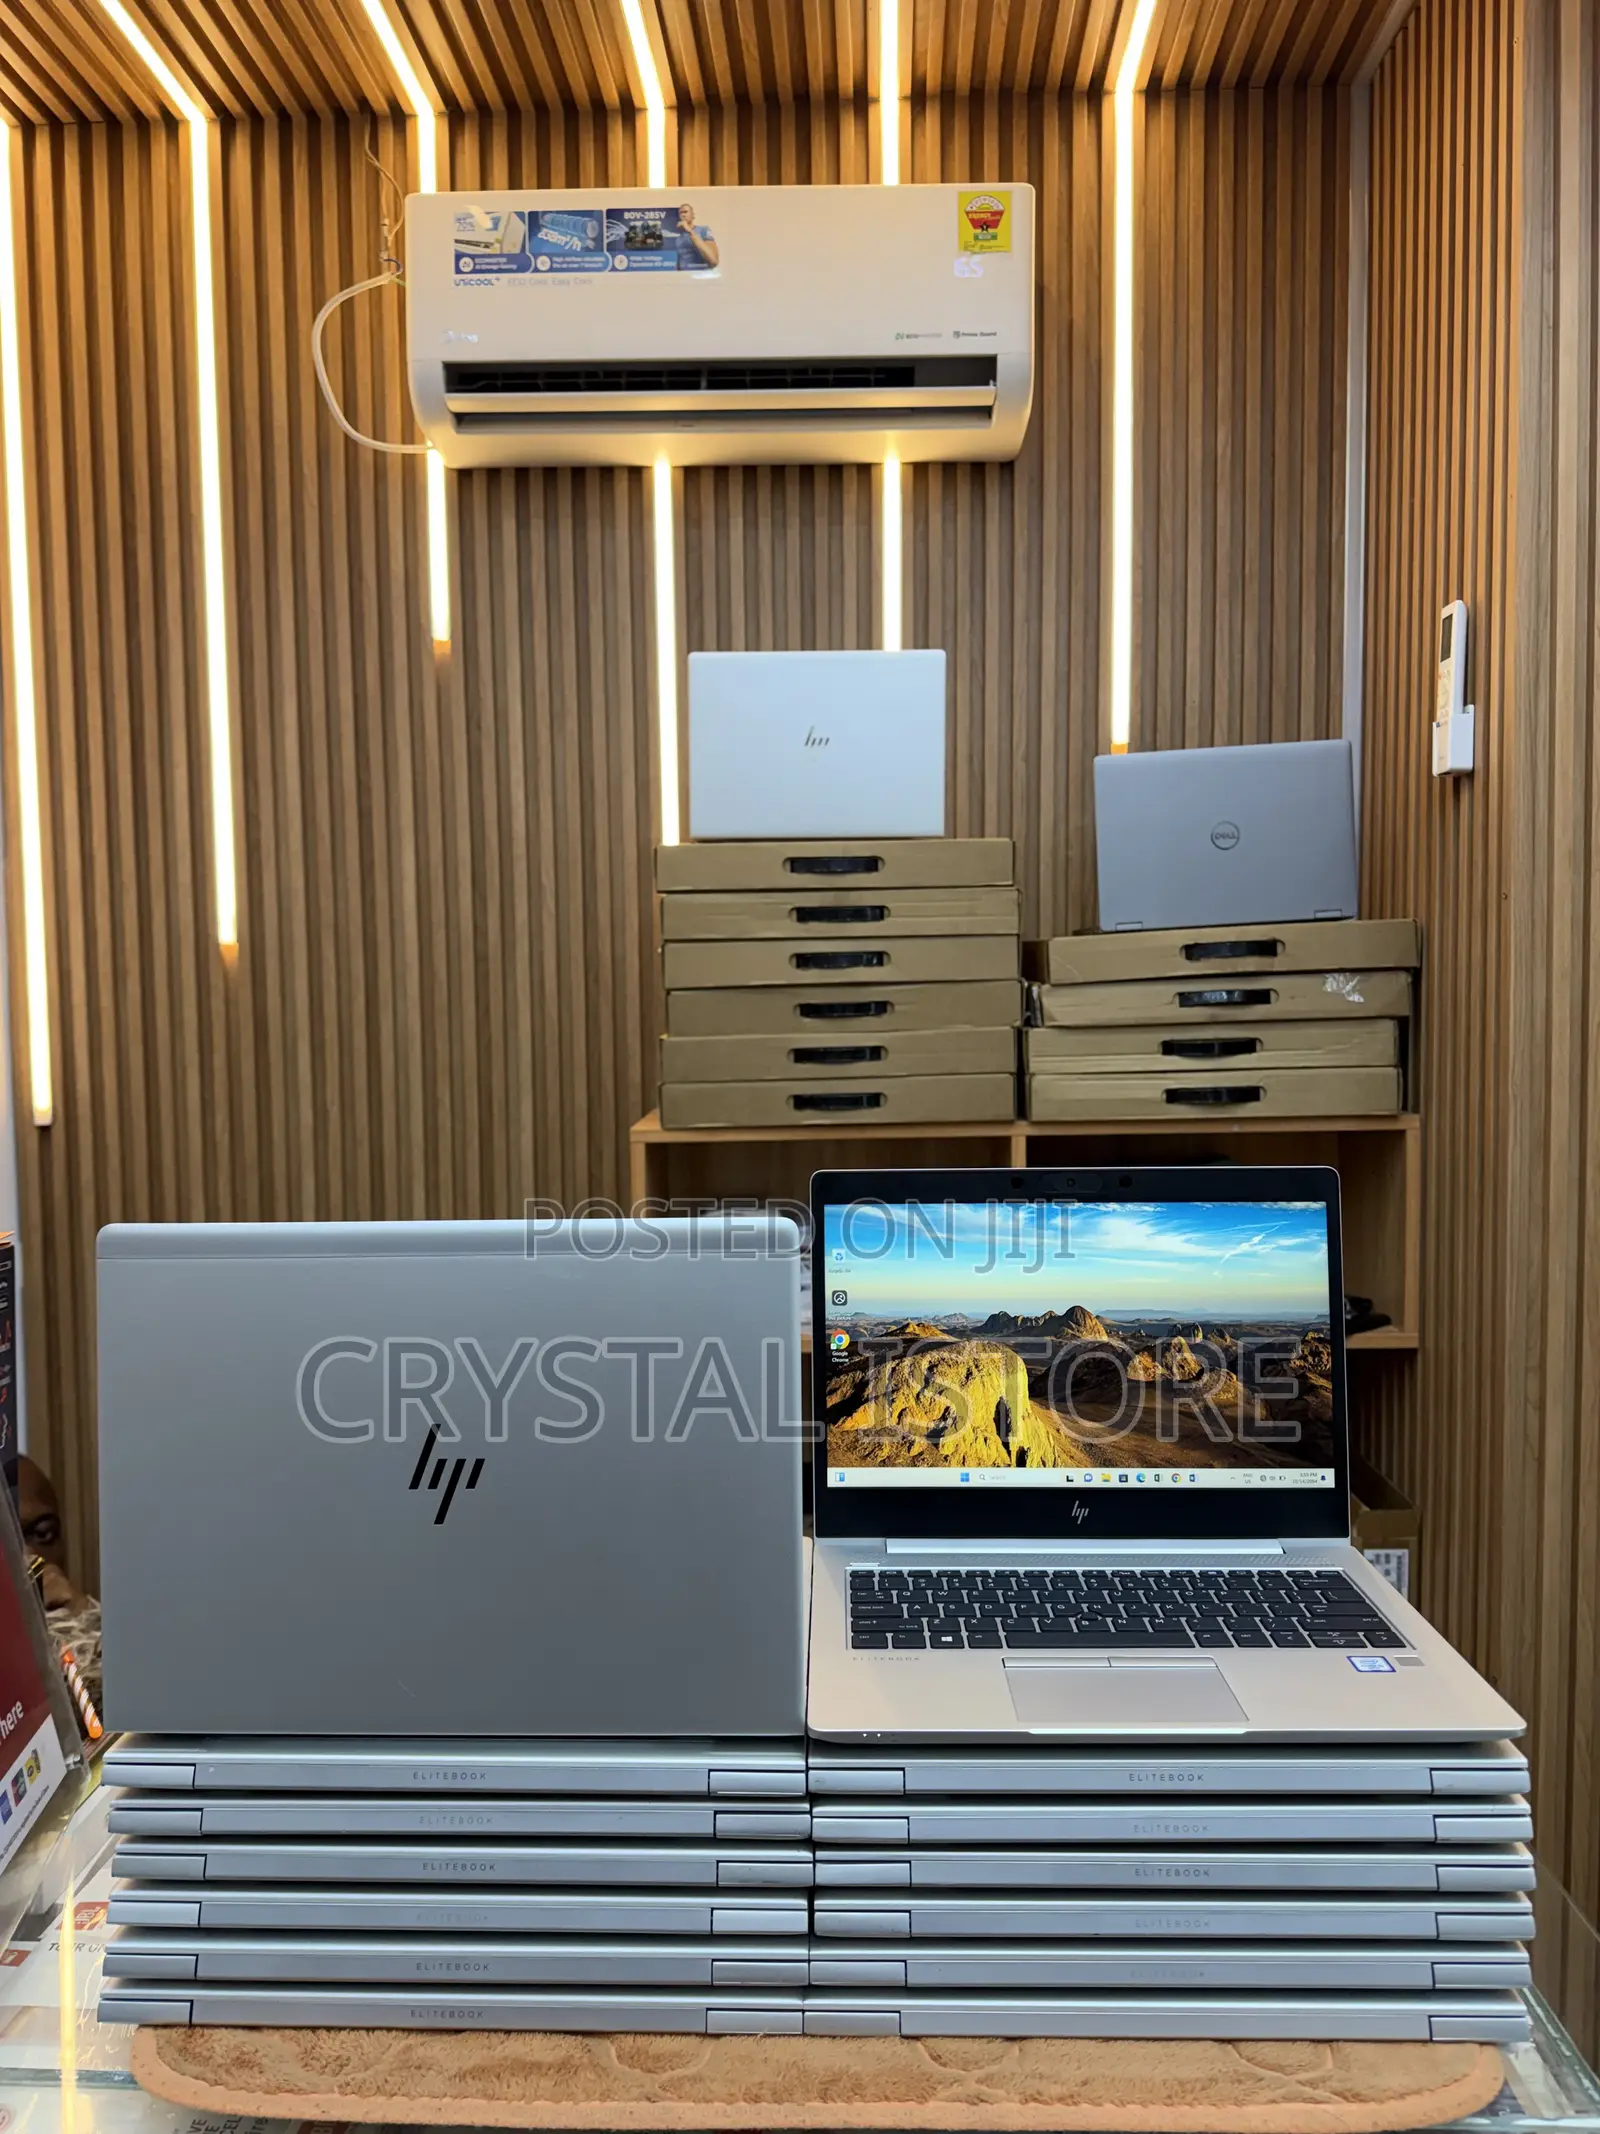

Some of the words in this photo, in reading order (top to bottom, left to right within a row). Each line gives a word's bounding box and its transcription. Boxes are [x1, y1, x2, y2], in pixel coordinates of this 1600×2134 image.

[1214, 831, 1238, 840] DELL
[408, 1423, 486, 1525] hp
[1071, 1500, 1089, 1525] hp
[413, 1771, 487, 1781] ELITEBOOK
[1129, 1773, 1204, 1782] ELITEBOOK
[419, 1815, 493, 1825] ELITEBOOK
[1133, 1824, 1209, 1834] ELITEBOOK
[422, 1862, 496, 1872] ELITEBOOK
[1135, 1868, 1210, 1877] ELITEBOOK
[1135, 1919, 1210, 1928] ELITEBOOK
[416, 1962, 490, 1972] ELITEBOOK
[410, 2009, 484, 2019] ELITEBOOK
